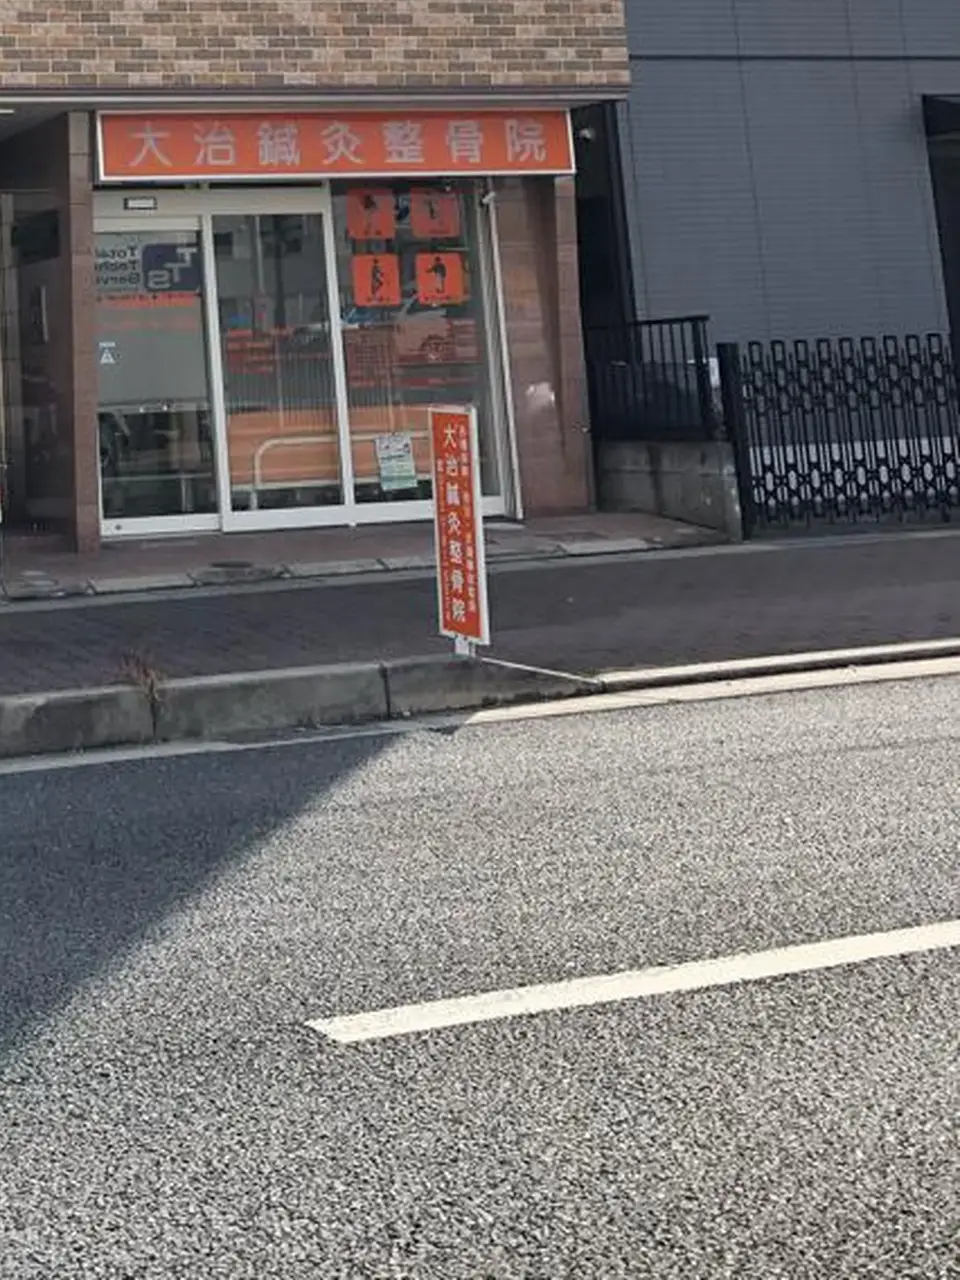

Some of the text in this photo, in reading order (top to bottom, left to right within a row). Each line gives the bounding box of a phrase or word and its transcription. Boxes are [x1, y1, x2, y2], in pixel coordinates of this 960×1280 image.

[129, 120, 547, 168] 大治鍼灸整骨院
[443, 424, 466, 623] 大治鍼灸整骨院
